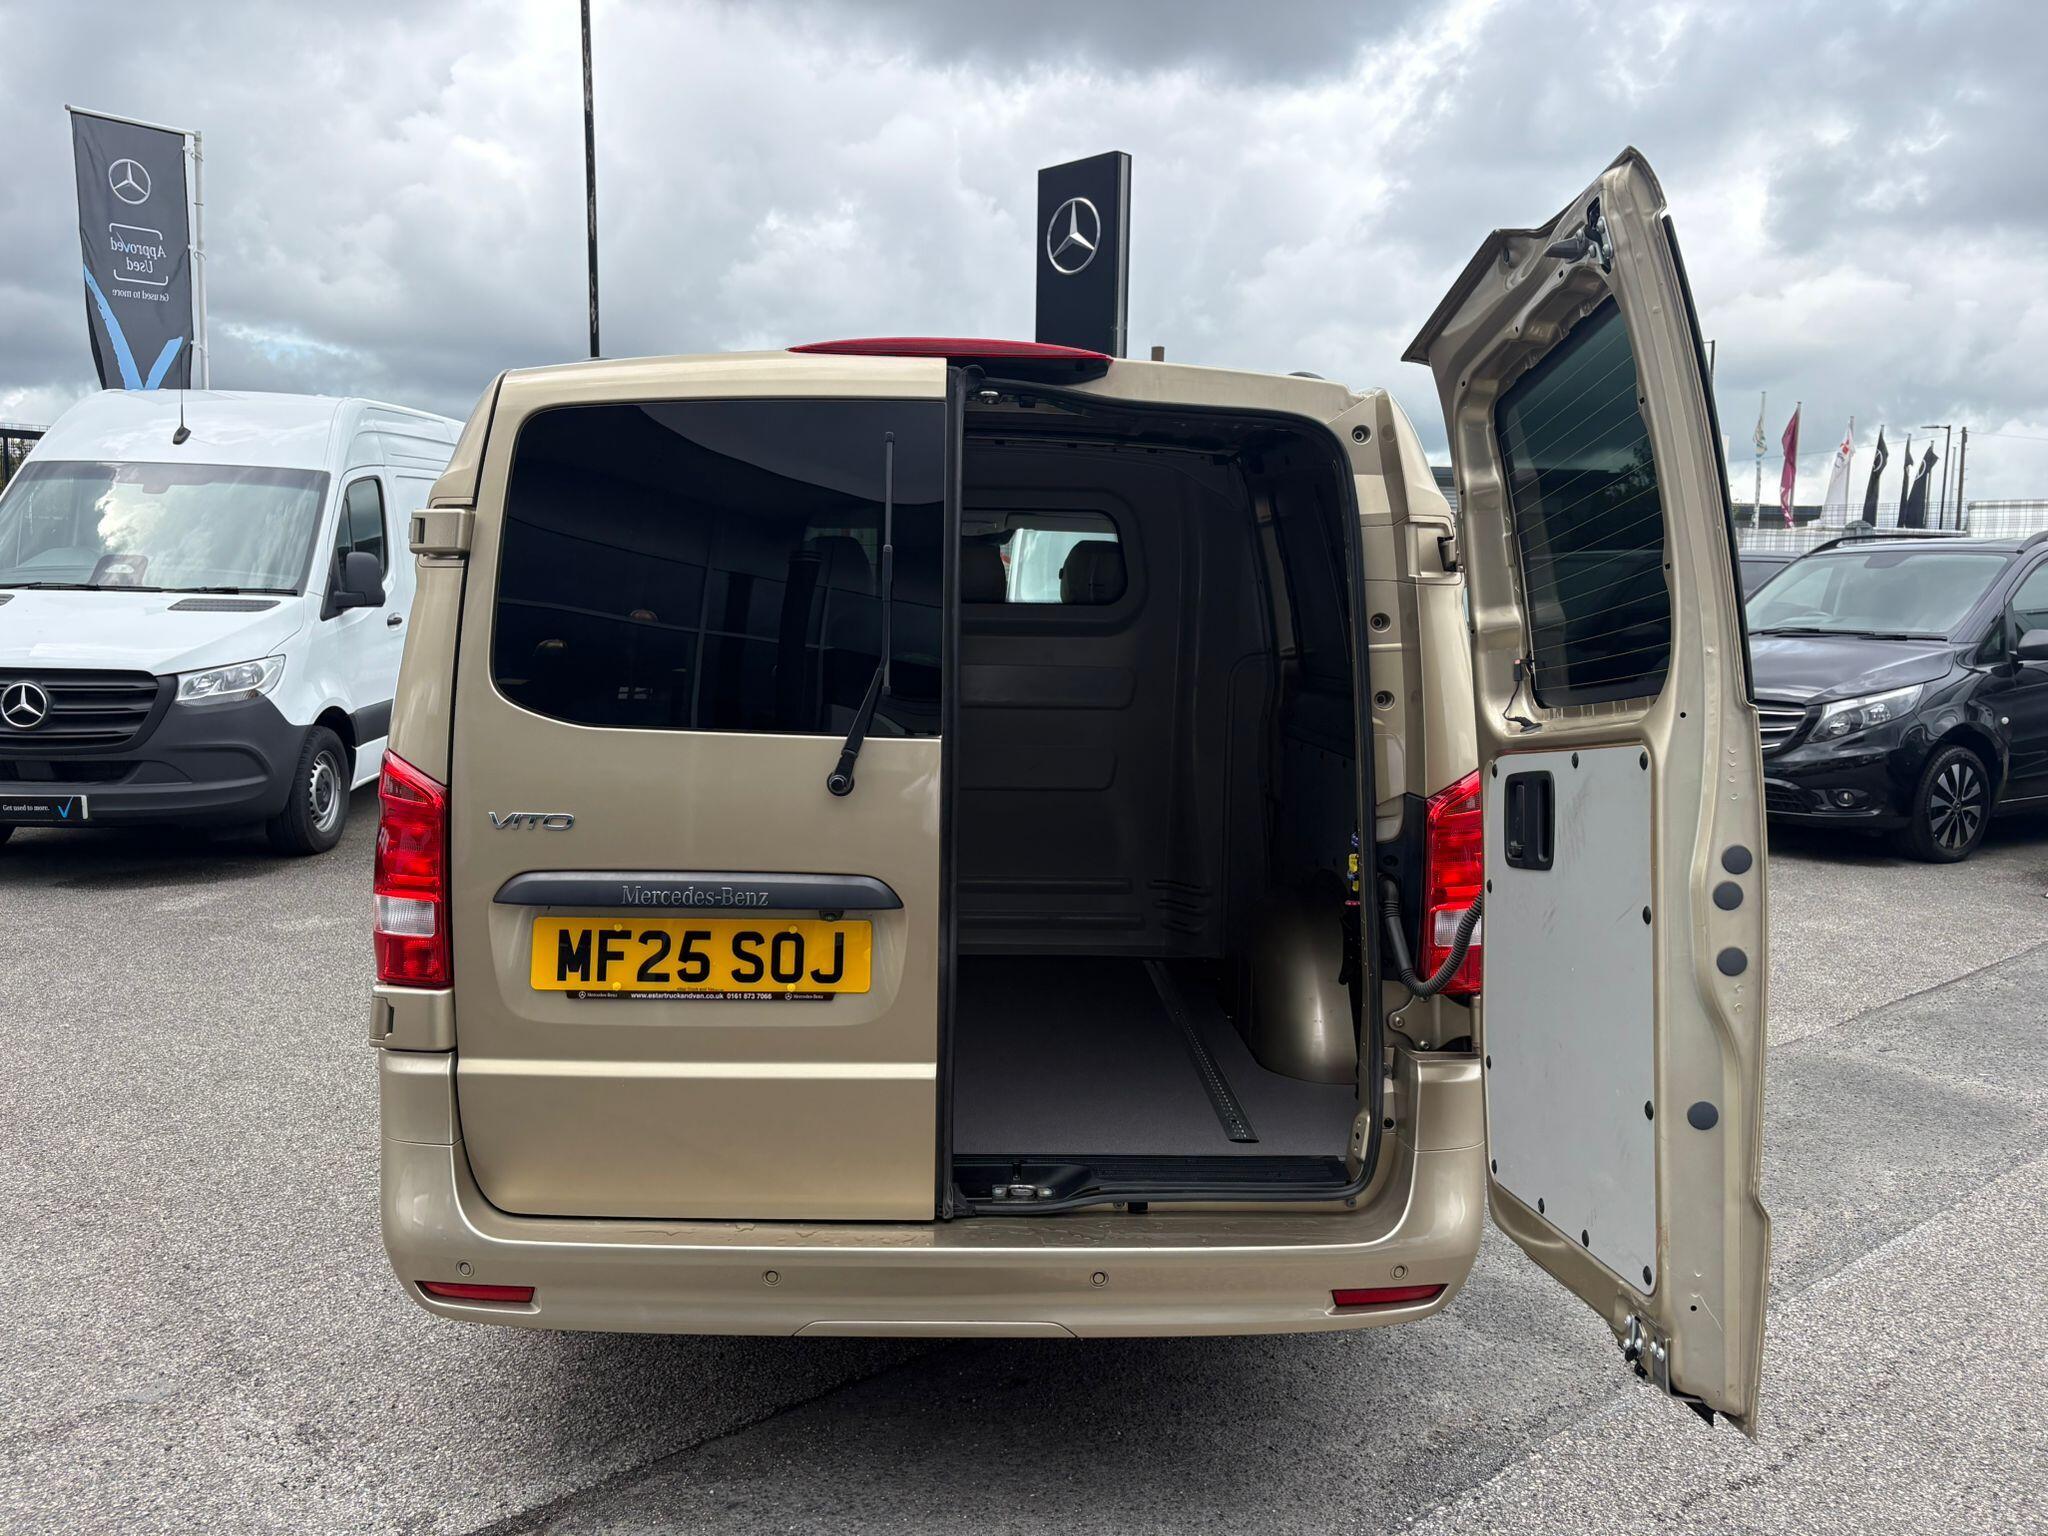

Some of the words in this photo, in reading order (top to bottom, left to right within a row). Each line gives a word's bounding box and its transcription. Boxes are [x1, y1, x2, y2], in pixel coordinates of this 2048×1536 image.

[487, 811, 576, 832] VITO
[621, 885, 769, 907] Mercedes-Benz
[556, 929, 712, 984] MF25
[731, 931, 845, 985] SOJ
